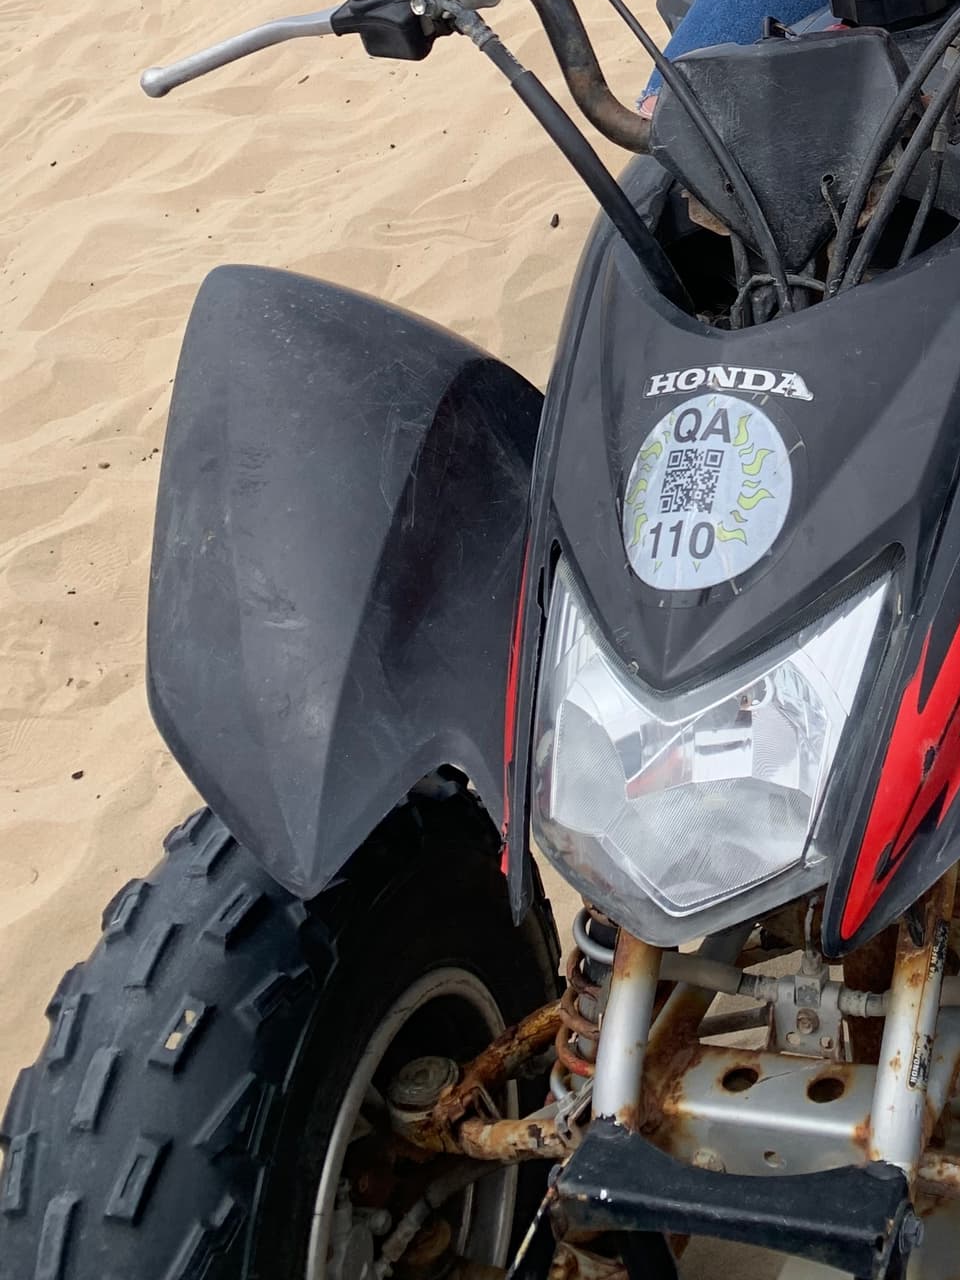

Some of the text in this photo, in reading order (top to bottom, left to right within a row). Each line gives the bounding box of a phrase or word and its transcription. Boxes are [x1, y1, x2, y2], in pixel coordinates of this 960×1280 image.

[645, 366, 815, 401] HONDA
[673, 407, 731, 444] QA
[649, 520, 716, 560] 110
